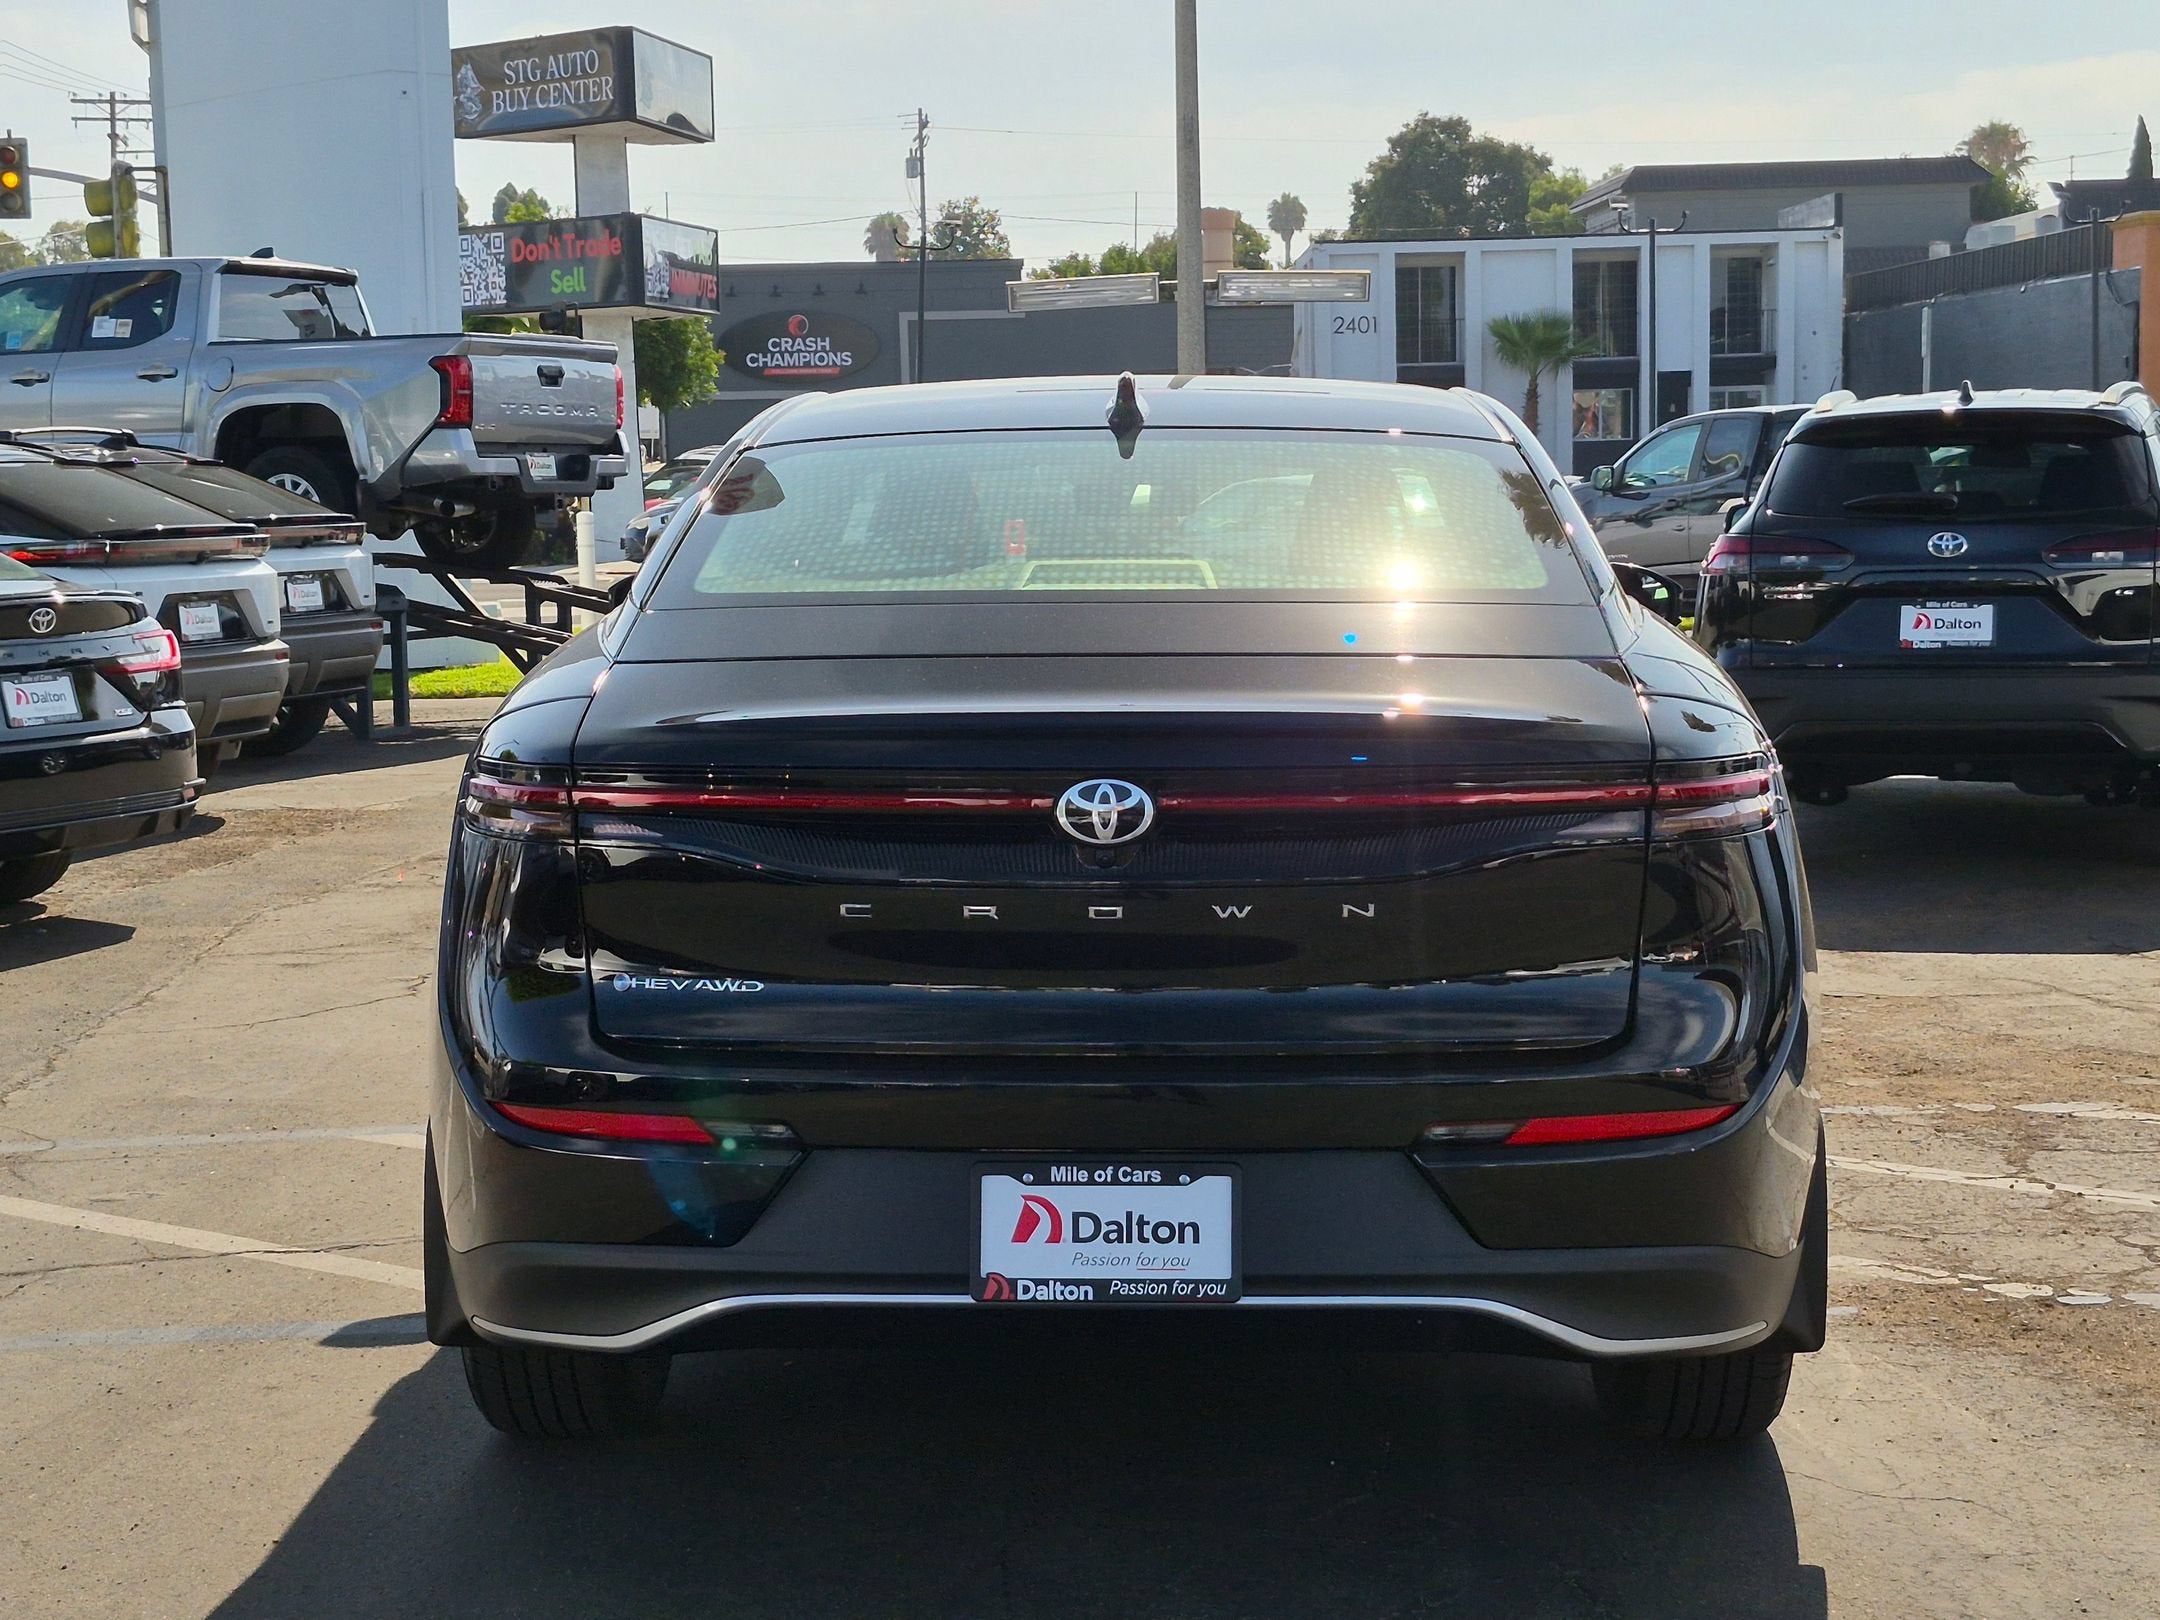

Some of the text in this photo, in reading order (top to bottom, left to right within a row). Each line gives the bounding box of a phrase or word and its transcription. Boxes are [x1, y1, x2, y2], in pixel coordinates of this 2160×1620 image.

[504, 49, 599, 85] STG AUTO
[491, 76, 614, 114] BUY CENTER
[512, 229, 622, 263] Don't Trade
[551, 266, 586, 294] Sell
[1333, 316, 1377, 334] 2401
[768, 337, 830, 352] CRASH
[746, 352, 852, 367] CHAMPIONS
[500, 402, 598, 417] TACOMA
[1934, 618, 1982, 629] Dalton
[30, 690, 66, 704] Dalton
[840, 904, 1375, 920] CROWN
[631, 978, 765, 992] HEV AWD
[1051, 1166, 1162, 1183] Mile of Cars
[1071, 1211, 1201, 1244] Dalton
[1072, 1251, 1191, 1270] Passion for you
[1017, 1279, 1227, 1301] Dalton Passion for you
